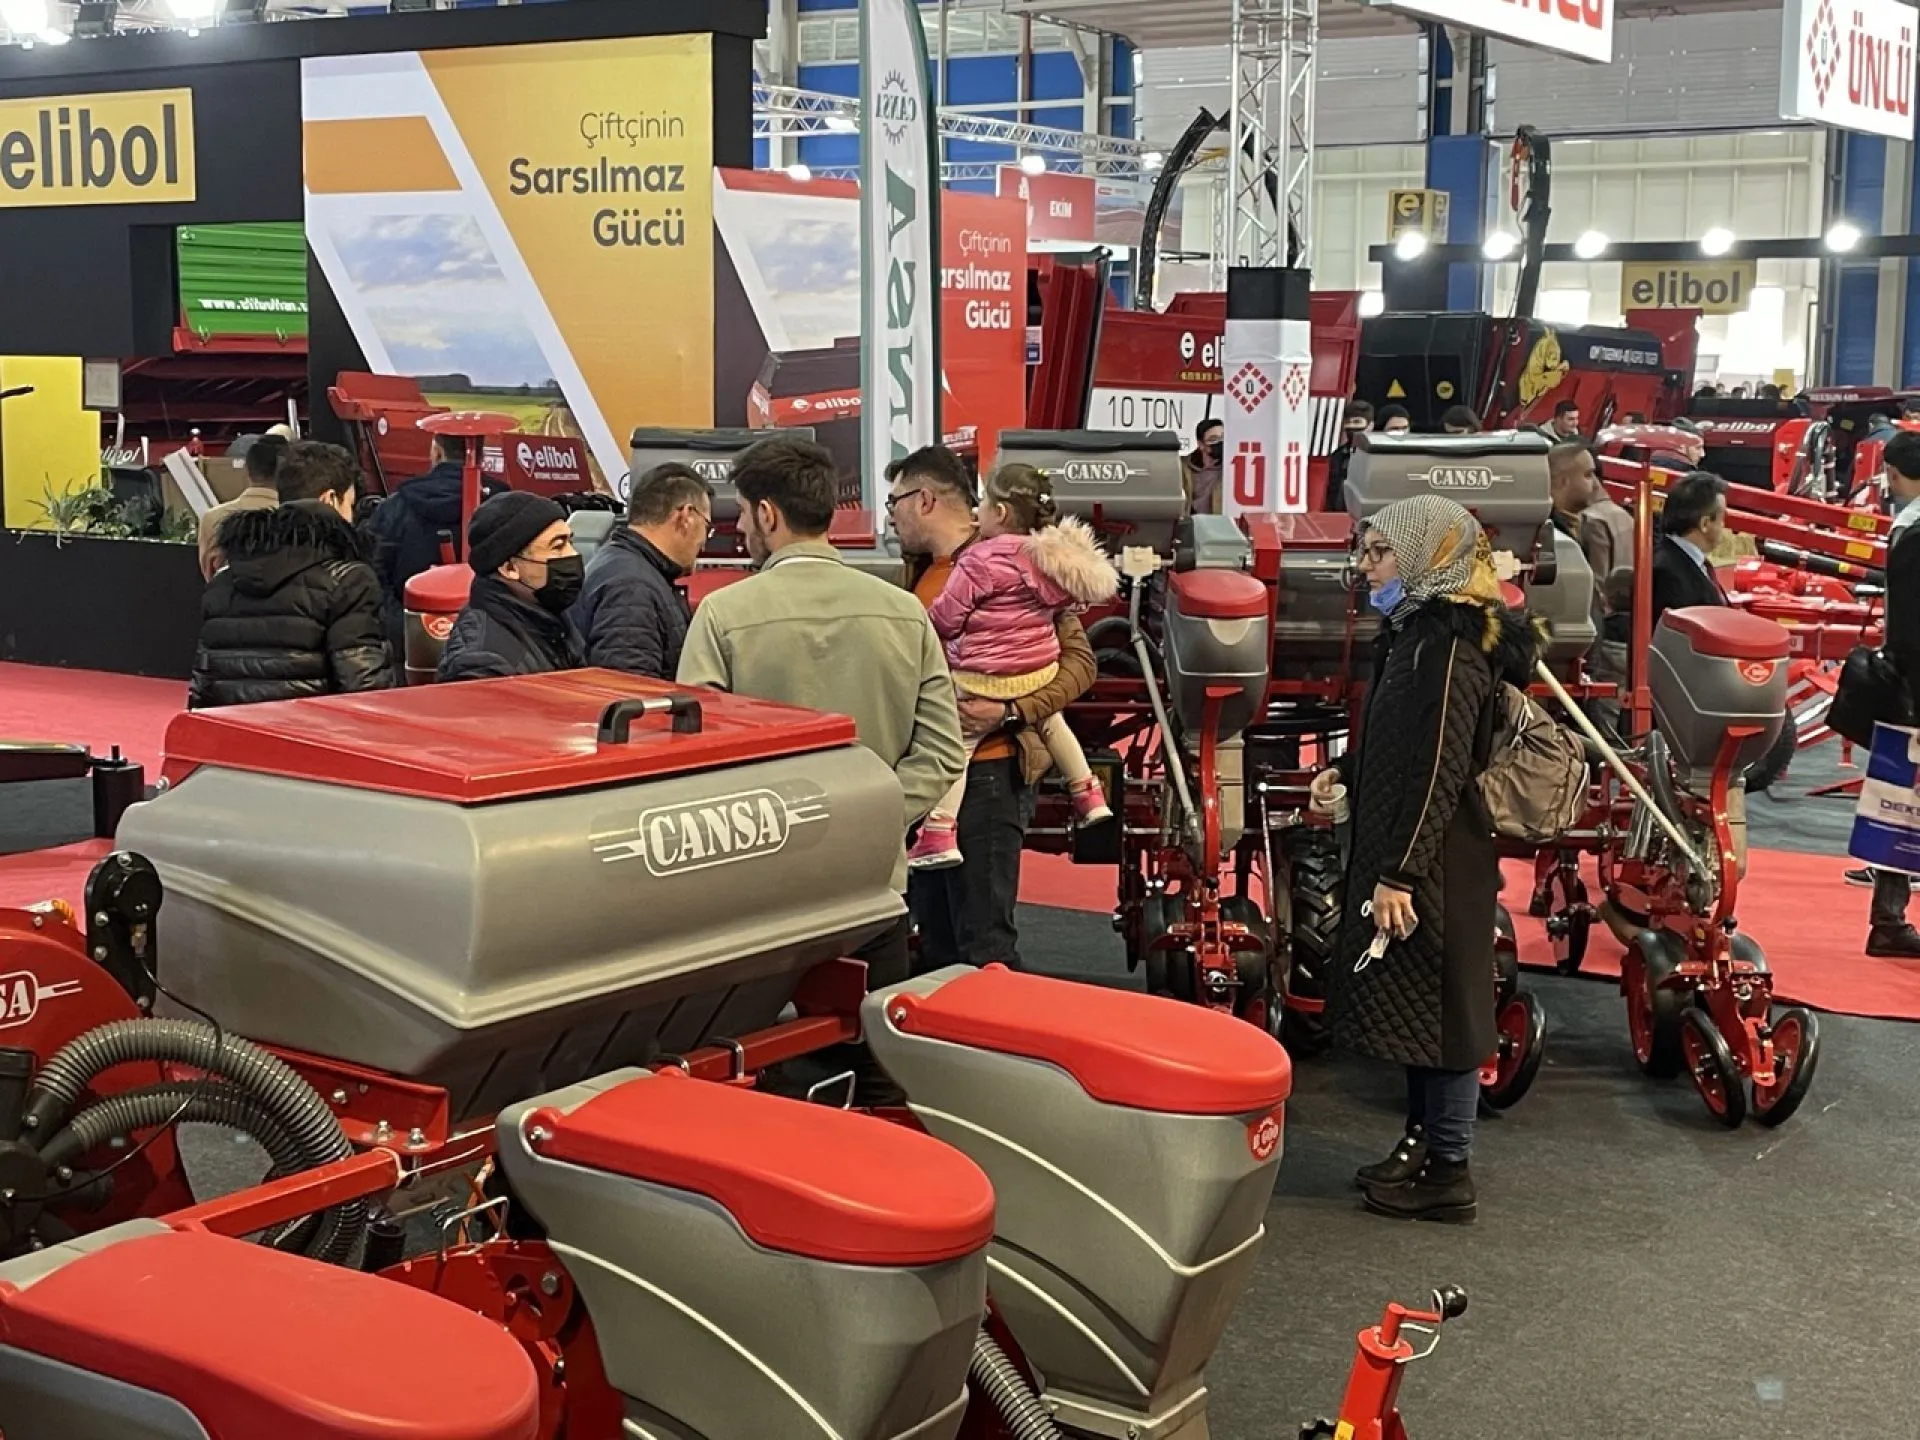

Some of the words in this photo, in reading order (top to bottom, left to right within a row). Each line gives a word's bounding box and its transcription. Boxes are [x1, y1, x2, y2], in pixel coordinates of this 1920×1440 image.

[1848, 9, 1911, 117] ÜNLÜ
[0, 103, 178, 190] elibol
[580, 110, 684, 149] Çiftçinin
[509, 156, 685, 195] Sarsılmaz
[593, 208, 685, 247] Gücü
[960, 228, 1011, 257] Çiftçinin
[1631, 269, 1740, 305] elibol
[965, 299, 1011, 329] Gücü
[1108, 395, 1134, 427] 10
[1141, 397, 1183, 430] TON
[535, 445, 577, 469] elibol
[695, 463, 733, 481] CAN
[1067, 463, 1124, 481] CANSA
[1231, 441, 1266, 506] Ü
[1284, 441, 1301, 505] Ü
[1431, 469, 1489, 486] CANSA
[651, 798, 782, 866] CANSA
